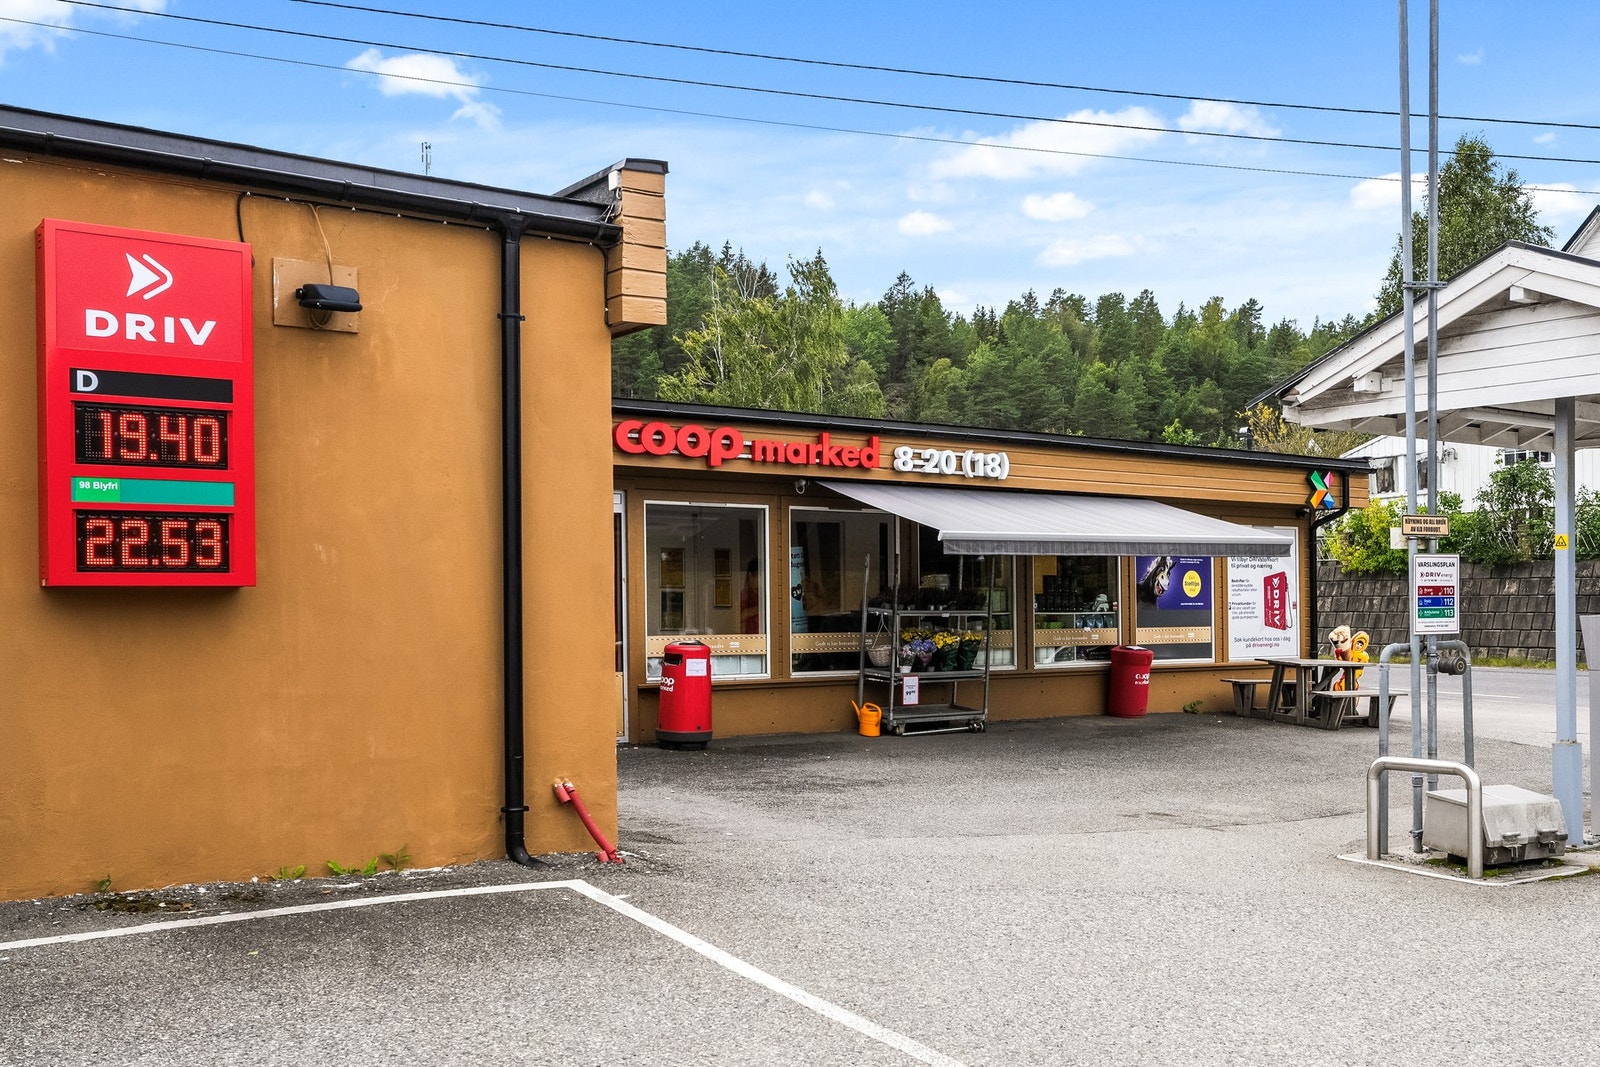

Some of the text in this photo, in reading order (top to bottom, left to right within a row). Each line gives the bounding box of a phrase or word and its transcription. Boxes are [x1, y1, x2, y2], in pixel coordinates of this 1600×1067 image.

[85, 308, 217, 346] DRIV
[76, 369, 99, 392] D
[100, 412, 220, 463] 19.40
[613, 419, 880, 469] coop marked
[893, 446, 1010, 480] 8-20 (18)
[79, 481, 118, 492] 98 Blyfri
[86, 519, 222, 566] 22.53
[1443, 587, 1454, 595] 110
[1444, 598, 1454, 606] 112
[1444, 609, 1454, 617] 113
